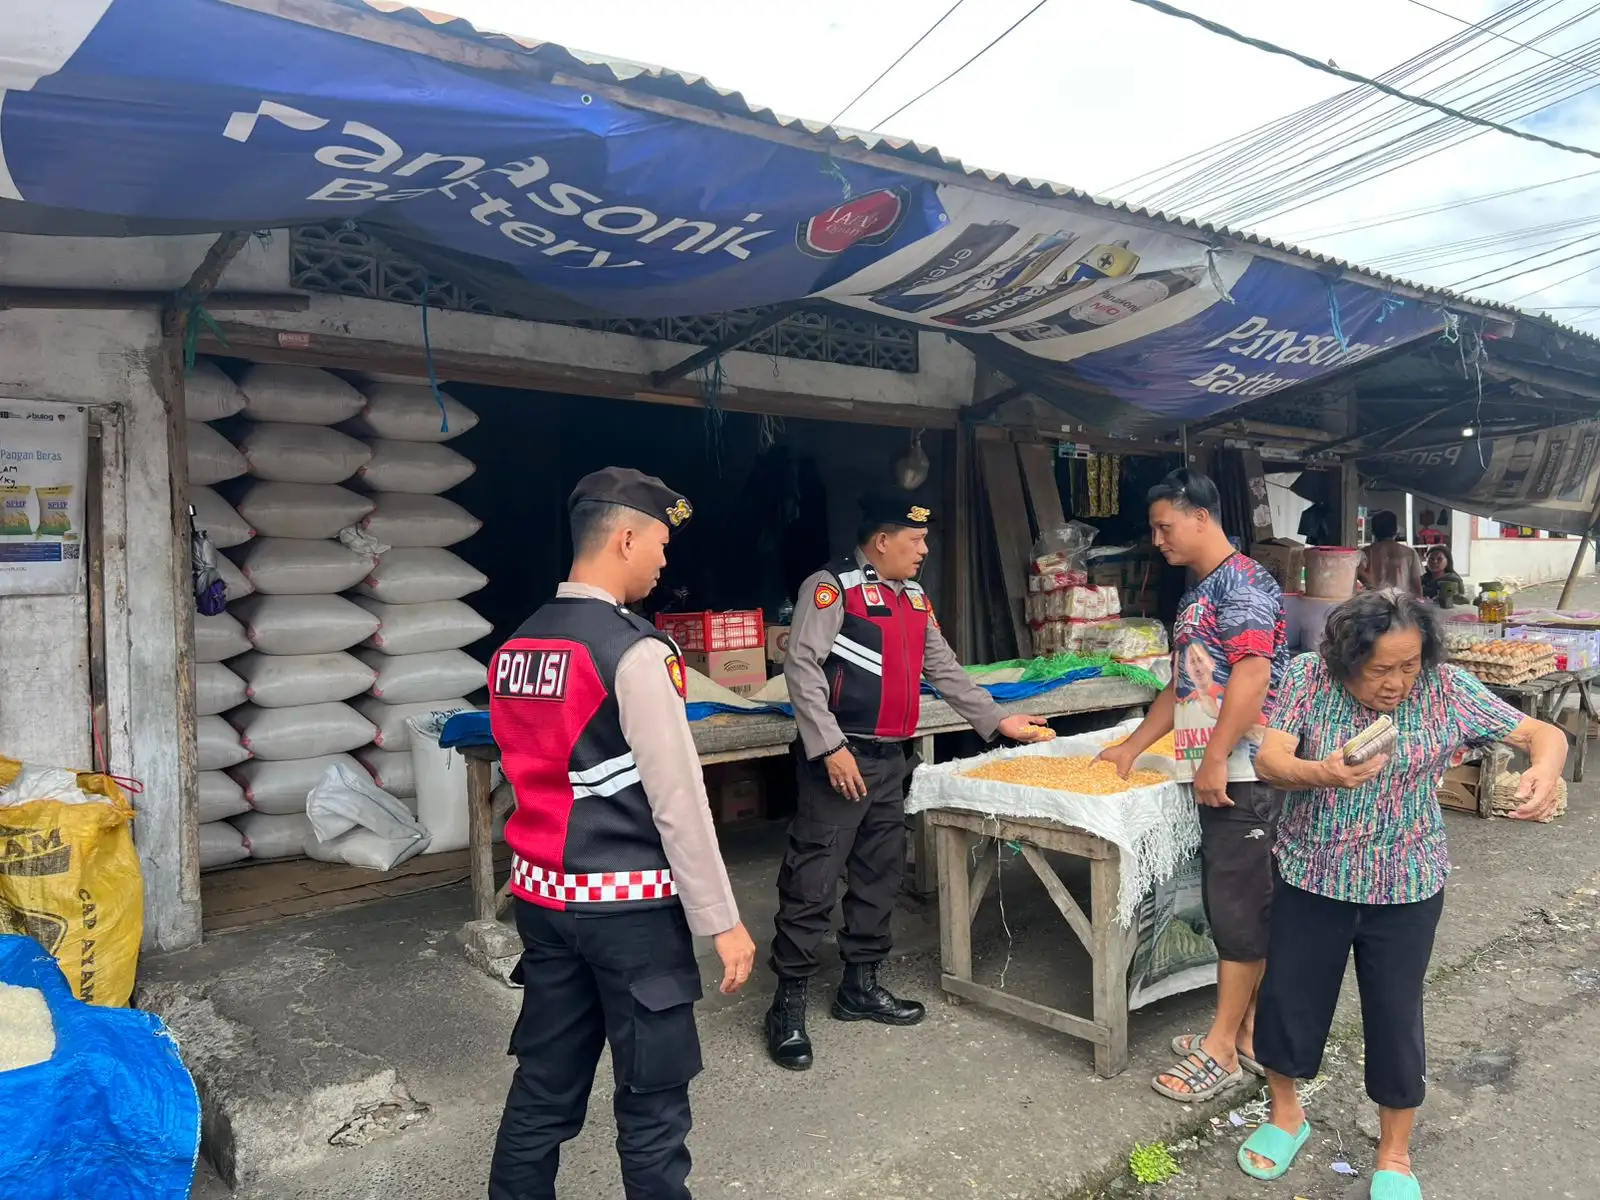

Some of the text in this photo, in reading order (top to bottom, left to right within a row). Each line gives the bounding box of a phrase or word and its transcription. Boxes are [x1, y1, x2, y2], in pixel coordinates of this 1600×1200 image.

[0, 449, 62, 462] Pangan Beras
[494, 651, 567, 697] POLISI
[78, 888, 98, 1003] CAP AYAM
